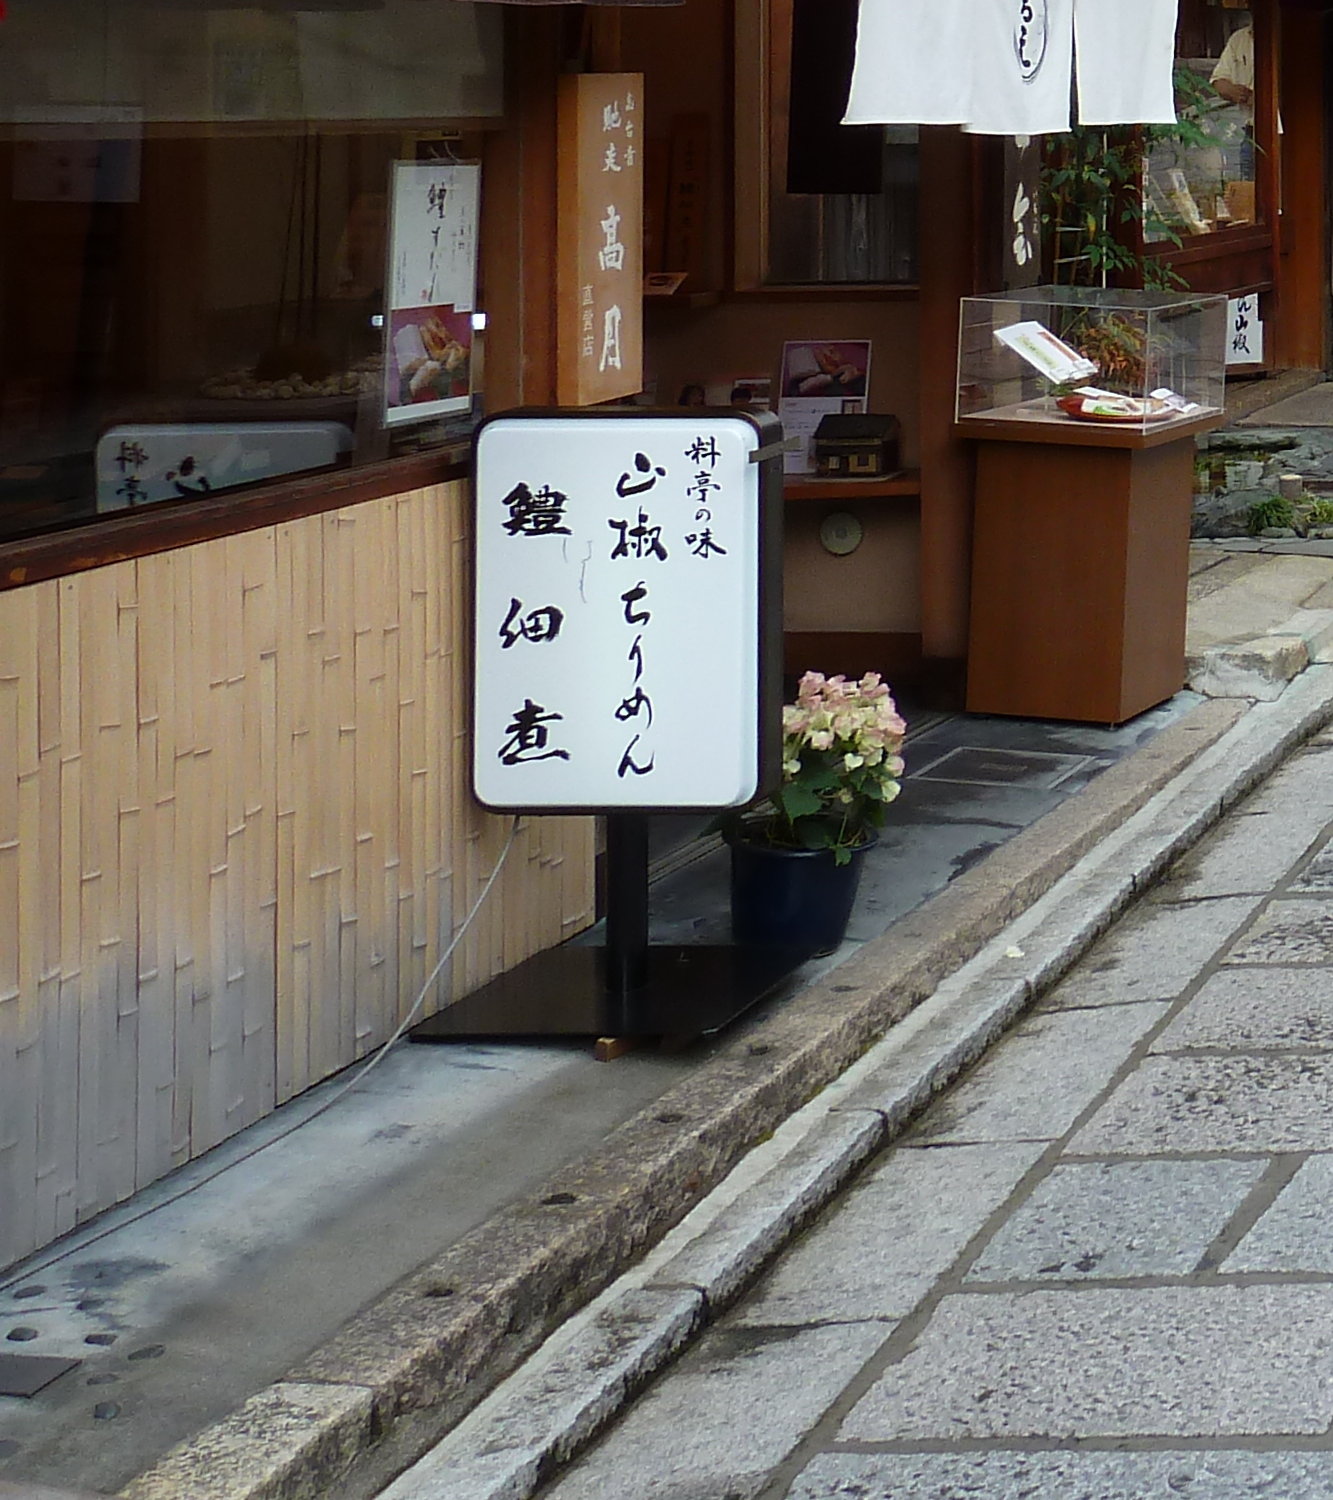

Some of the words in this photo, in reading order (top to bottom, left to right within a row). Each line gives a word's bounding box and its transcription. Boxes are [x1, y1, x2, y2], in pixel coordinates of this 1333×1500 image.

[582, 283, 595, 358] 直営店
[683, 435, 727, 560] 料亭の味
[607, 451, 670, 780] 山椒ちりめん
